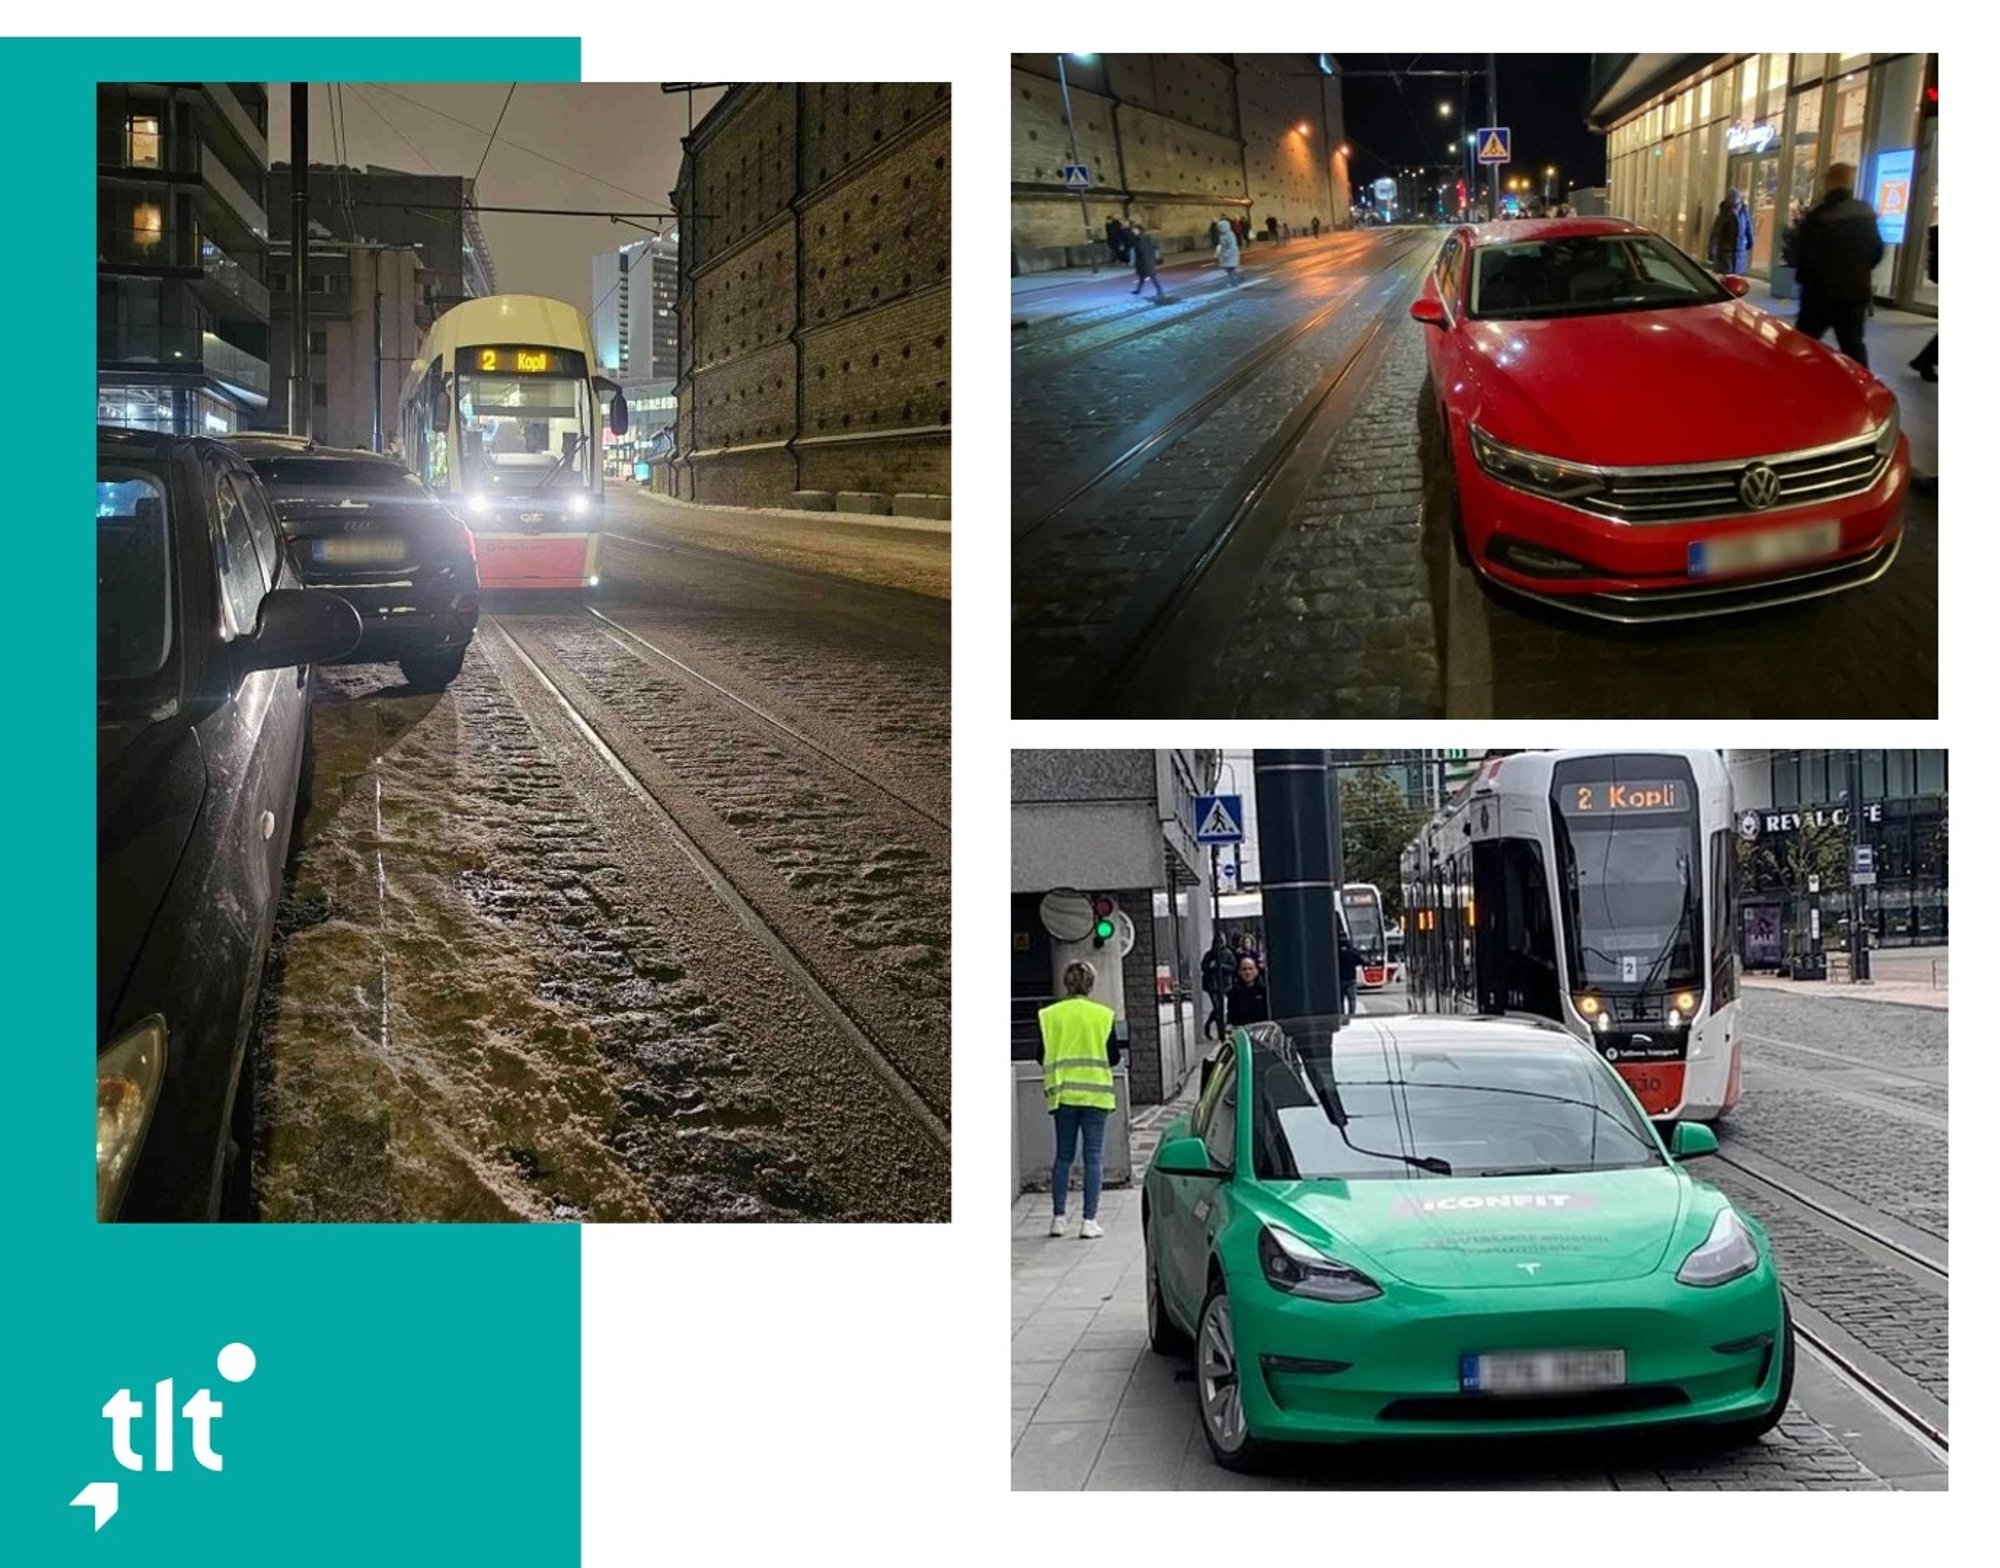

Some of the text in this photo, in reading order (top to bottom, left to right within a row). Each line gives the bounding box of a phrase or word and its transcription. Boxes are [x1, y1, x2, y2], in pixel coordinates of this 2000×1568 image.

[482, 350, 496, 371] 2
[1578, 784, 1675, 810] 2 Kopli
[1626, 963, 1634, 974] 2
